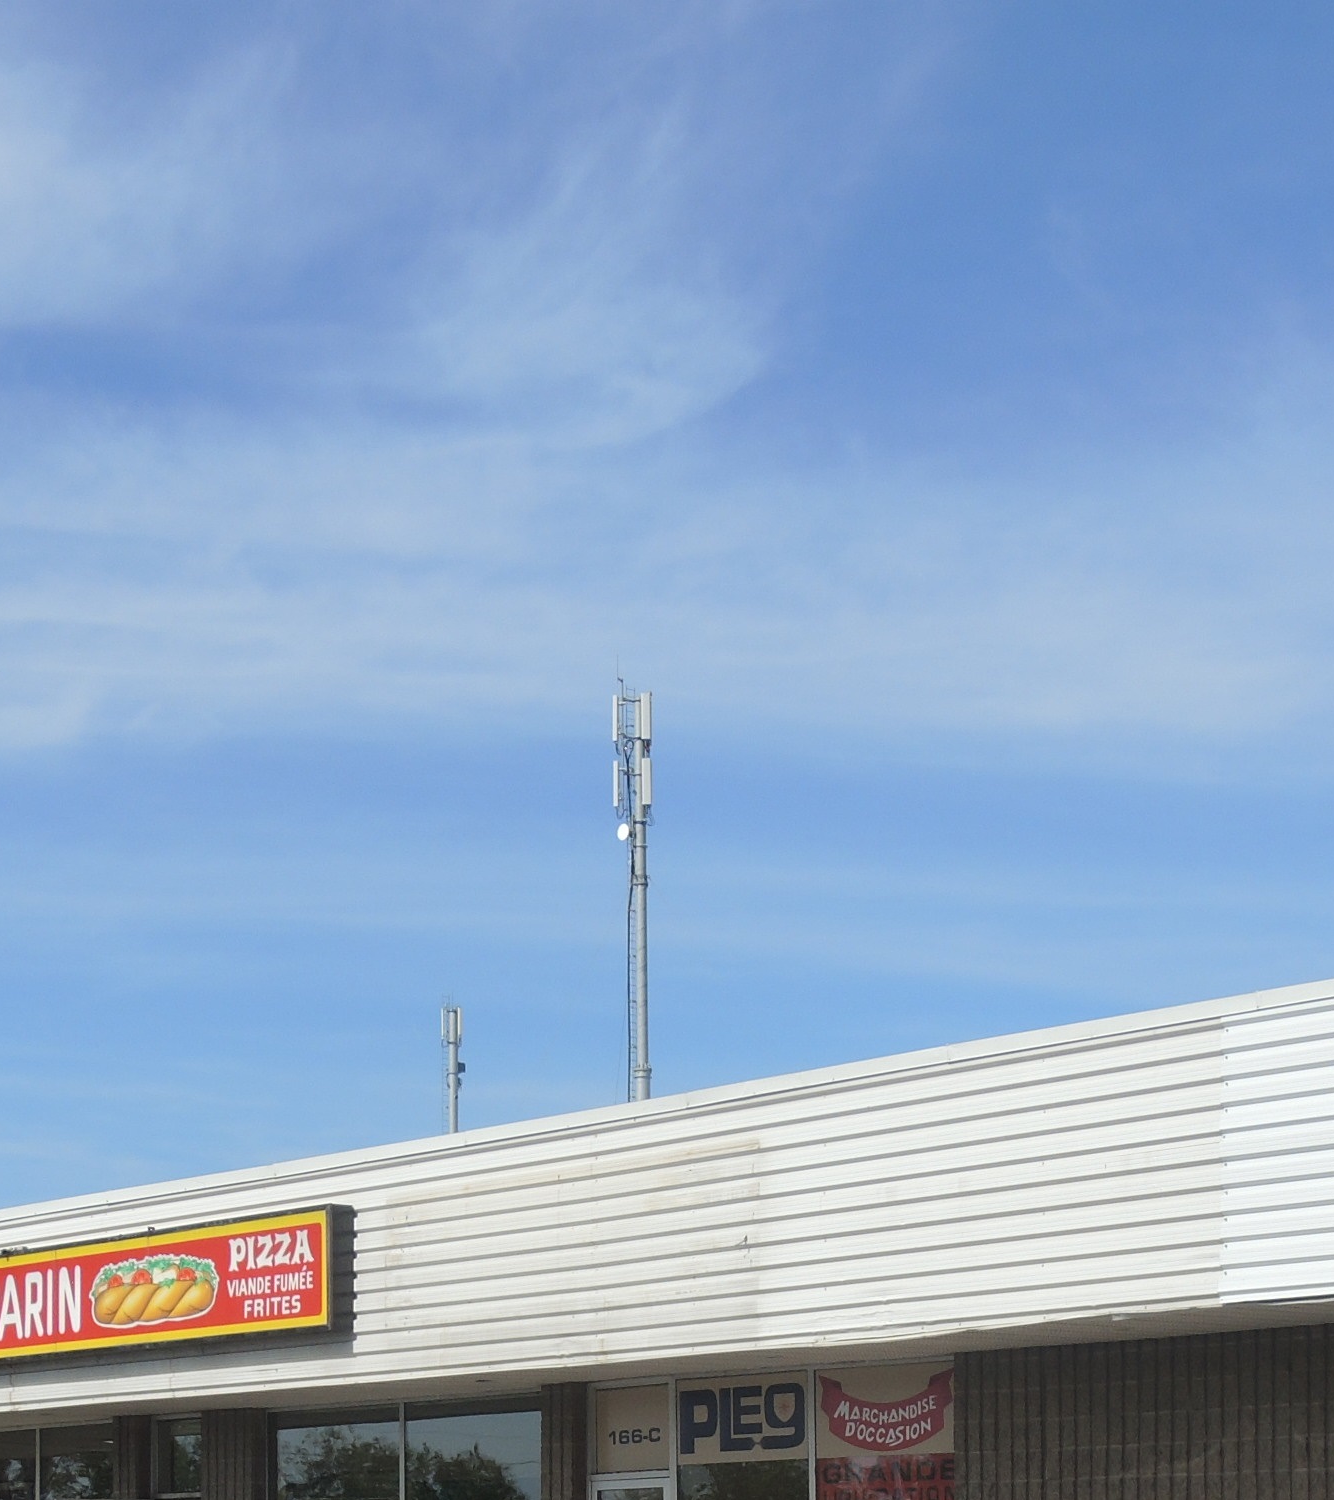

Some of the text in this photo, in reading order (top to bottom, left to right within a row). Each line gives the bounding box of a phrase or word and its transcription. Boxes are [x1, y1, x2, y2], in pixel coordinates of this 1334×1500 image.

[228, 1229, 315, 1272] PIZZA
[227, 1264, 314, 1298] VIANDE FUMÉE
[243, 1294, 301, 1319] FRITES
[833, 1394, 938, 1426] MARCHANDISE
[608, 1427, 661, 1446] 166-C
[844, 1417, 932, 1447] D'OCCASION
[823, 1458, 955, 1484] GRANDE
